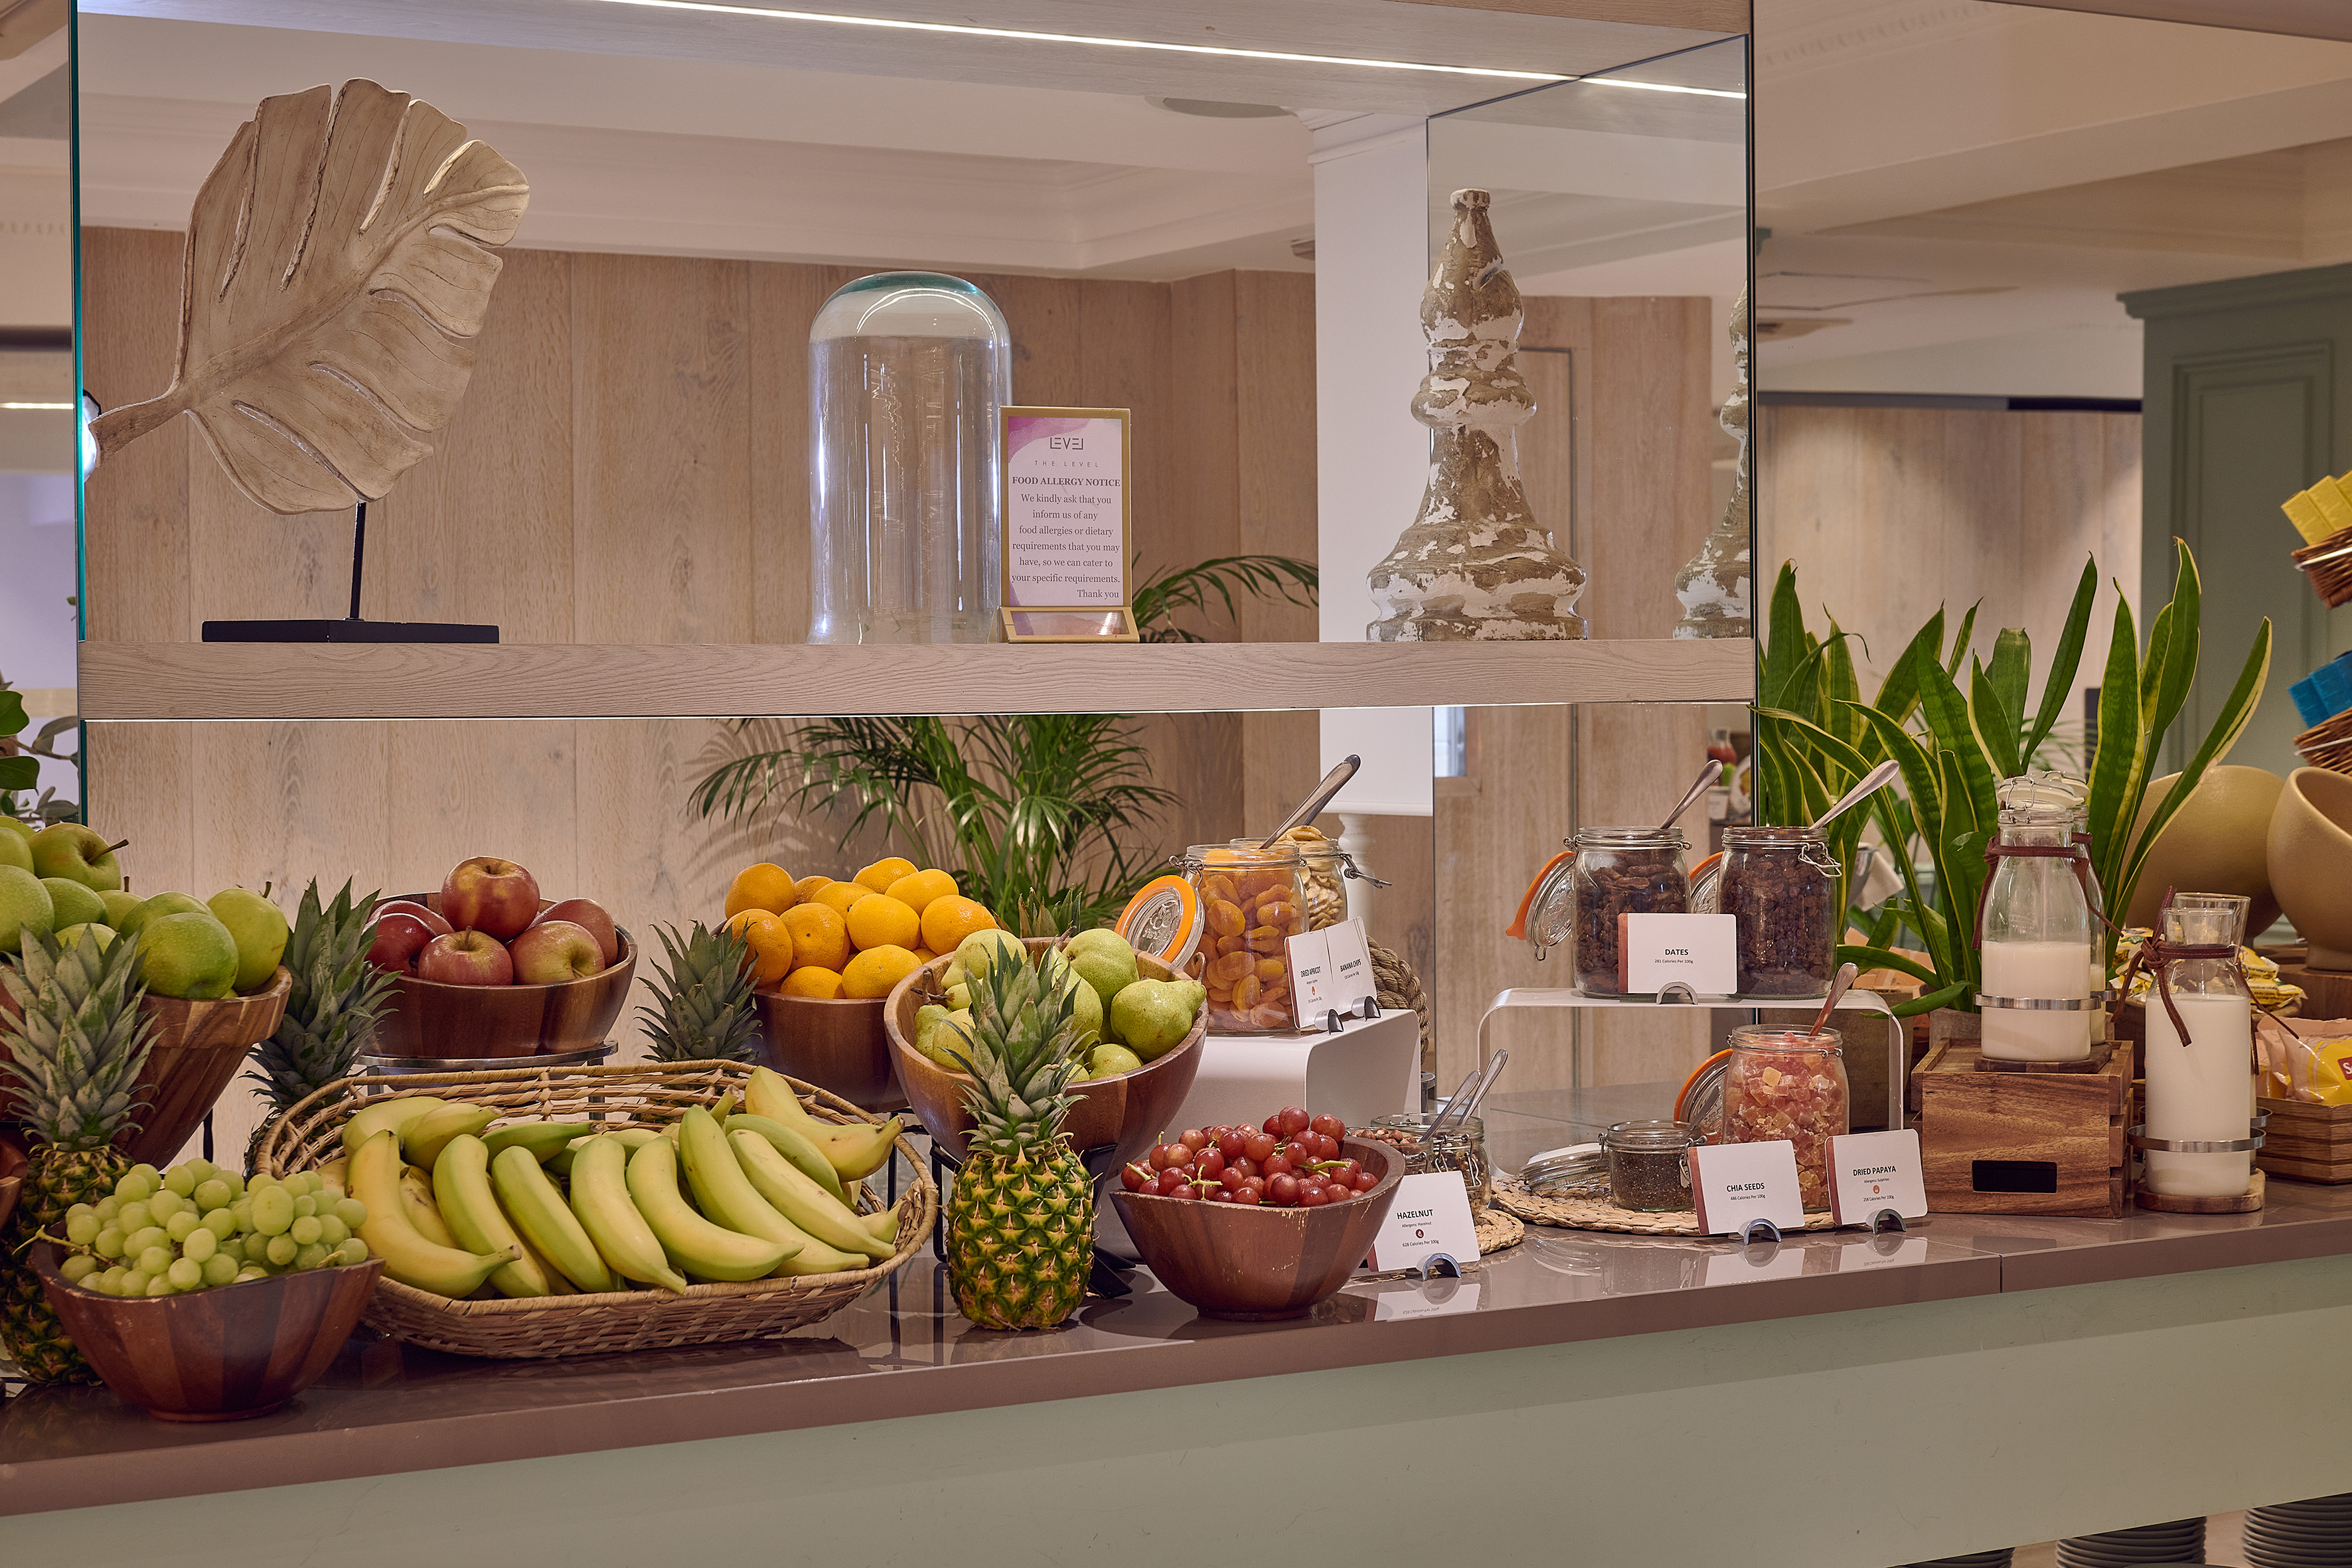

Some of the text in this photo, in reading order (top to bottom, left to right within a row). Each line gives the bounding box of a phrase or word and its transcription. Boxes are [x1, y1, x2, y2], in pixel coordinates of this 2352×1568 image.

[1050, 437, 1083, 450] LEVEL
[1036, 494, 1062, 505] kindly
[1063, 495, 1077, 503] ask
[1079, 495, 1095, 504] that
[1032, 510, 1060, 518] inform
[1073, 510, 1082, 519] of
[1019, 525, 1037, 534] food
[1039, 526, 1073, 536] allergies
[1085, 526, 1113, 537] dietary
[1012, 542, 1066, 551] requirements
[1068, 542, 1084, 551] that
[1020, 557, 1040, 567] have,
[1012, 573, 1120, 584] your specific requirements.
[1077, 589, 1103, 598] Thank
[1340, 961, 1354, 973] BANANA
[1853, 1165, 1897, 1176] DRIED PAPAYA
[1397, 1209, 1433, 1219] HAZELNUT
